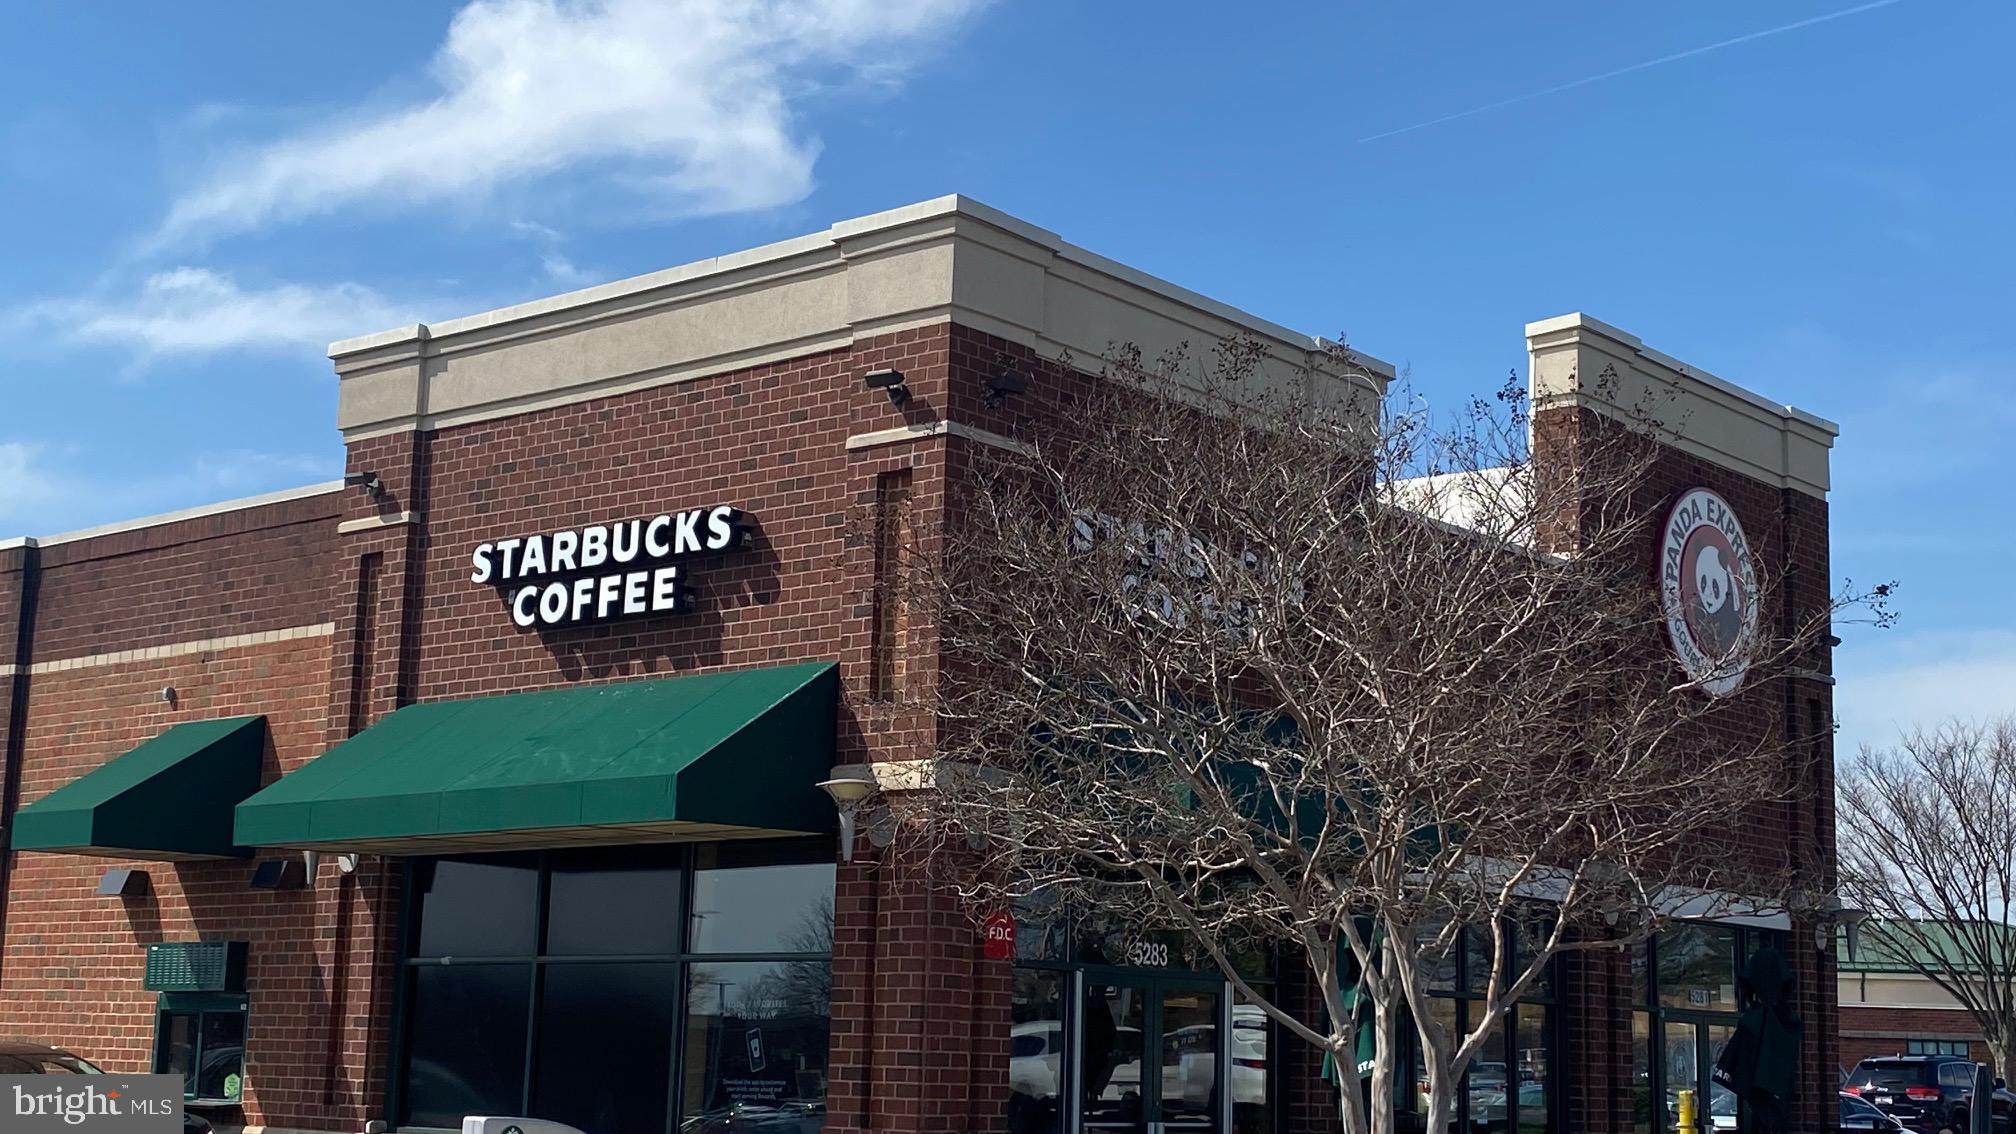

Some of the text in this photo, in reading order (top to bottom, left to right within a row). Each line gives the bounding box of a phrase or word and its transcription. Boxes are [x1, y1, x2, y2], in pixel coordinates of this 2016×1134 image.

[470, 505, 732, 584] STARBUCKS
[1665, 498, 1702, 583] PANDA
[512, 566, 677, 627] COFFEE
[1134, 942, 1168, 966] 5283
[738, 1011, 758, 1020] YOUR
